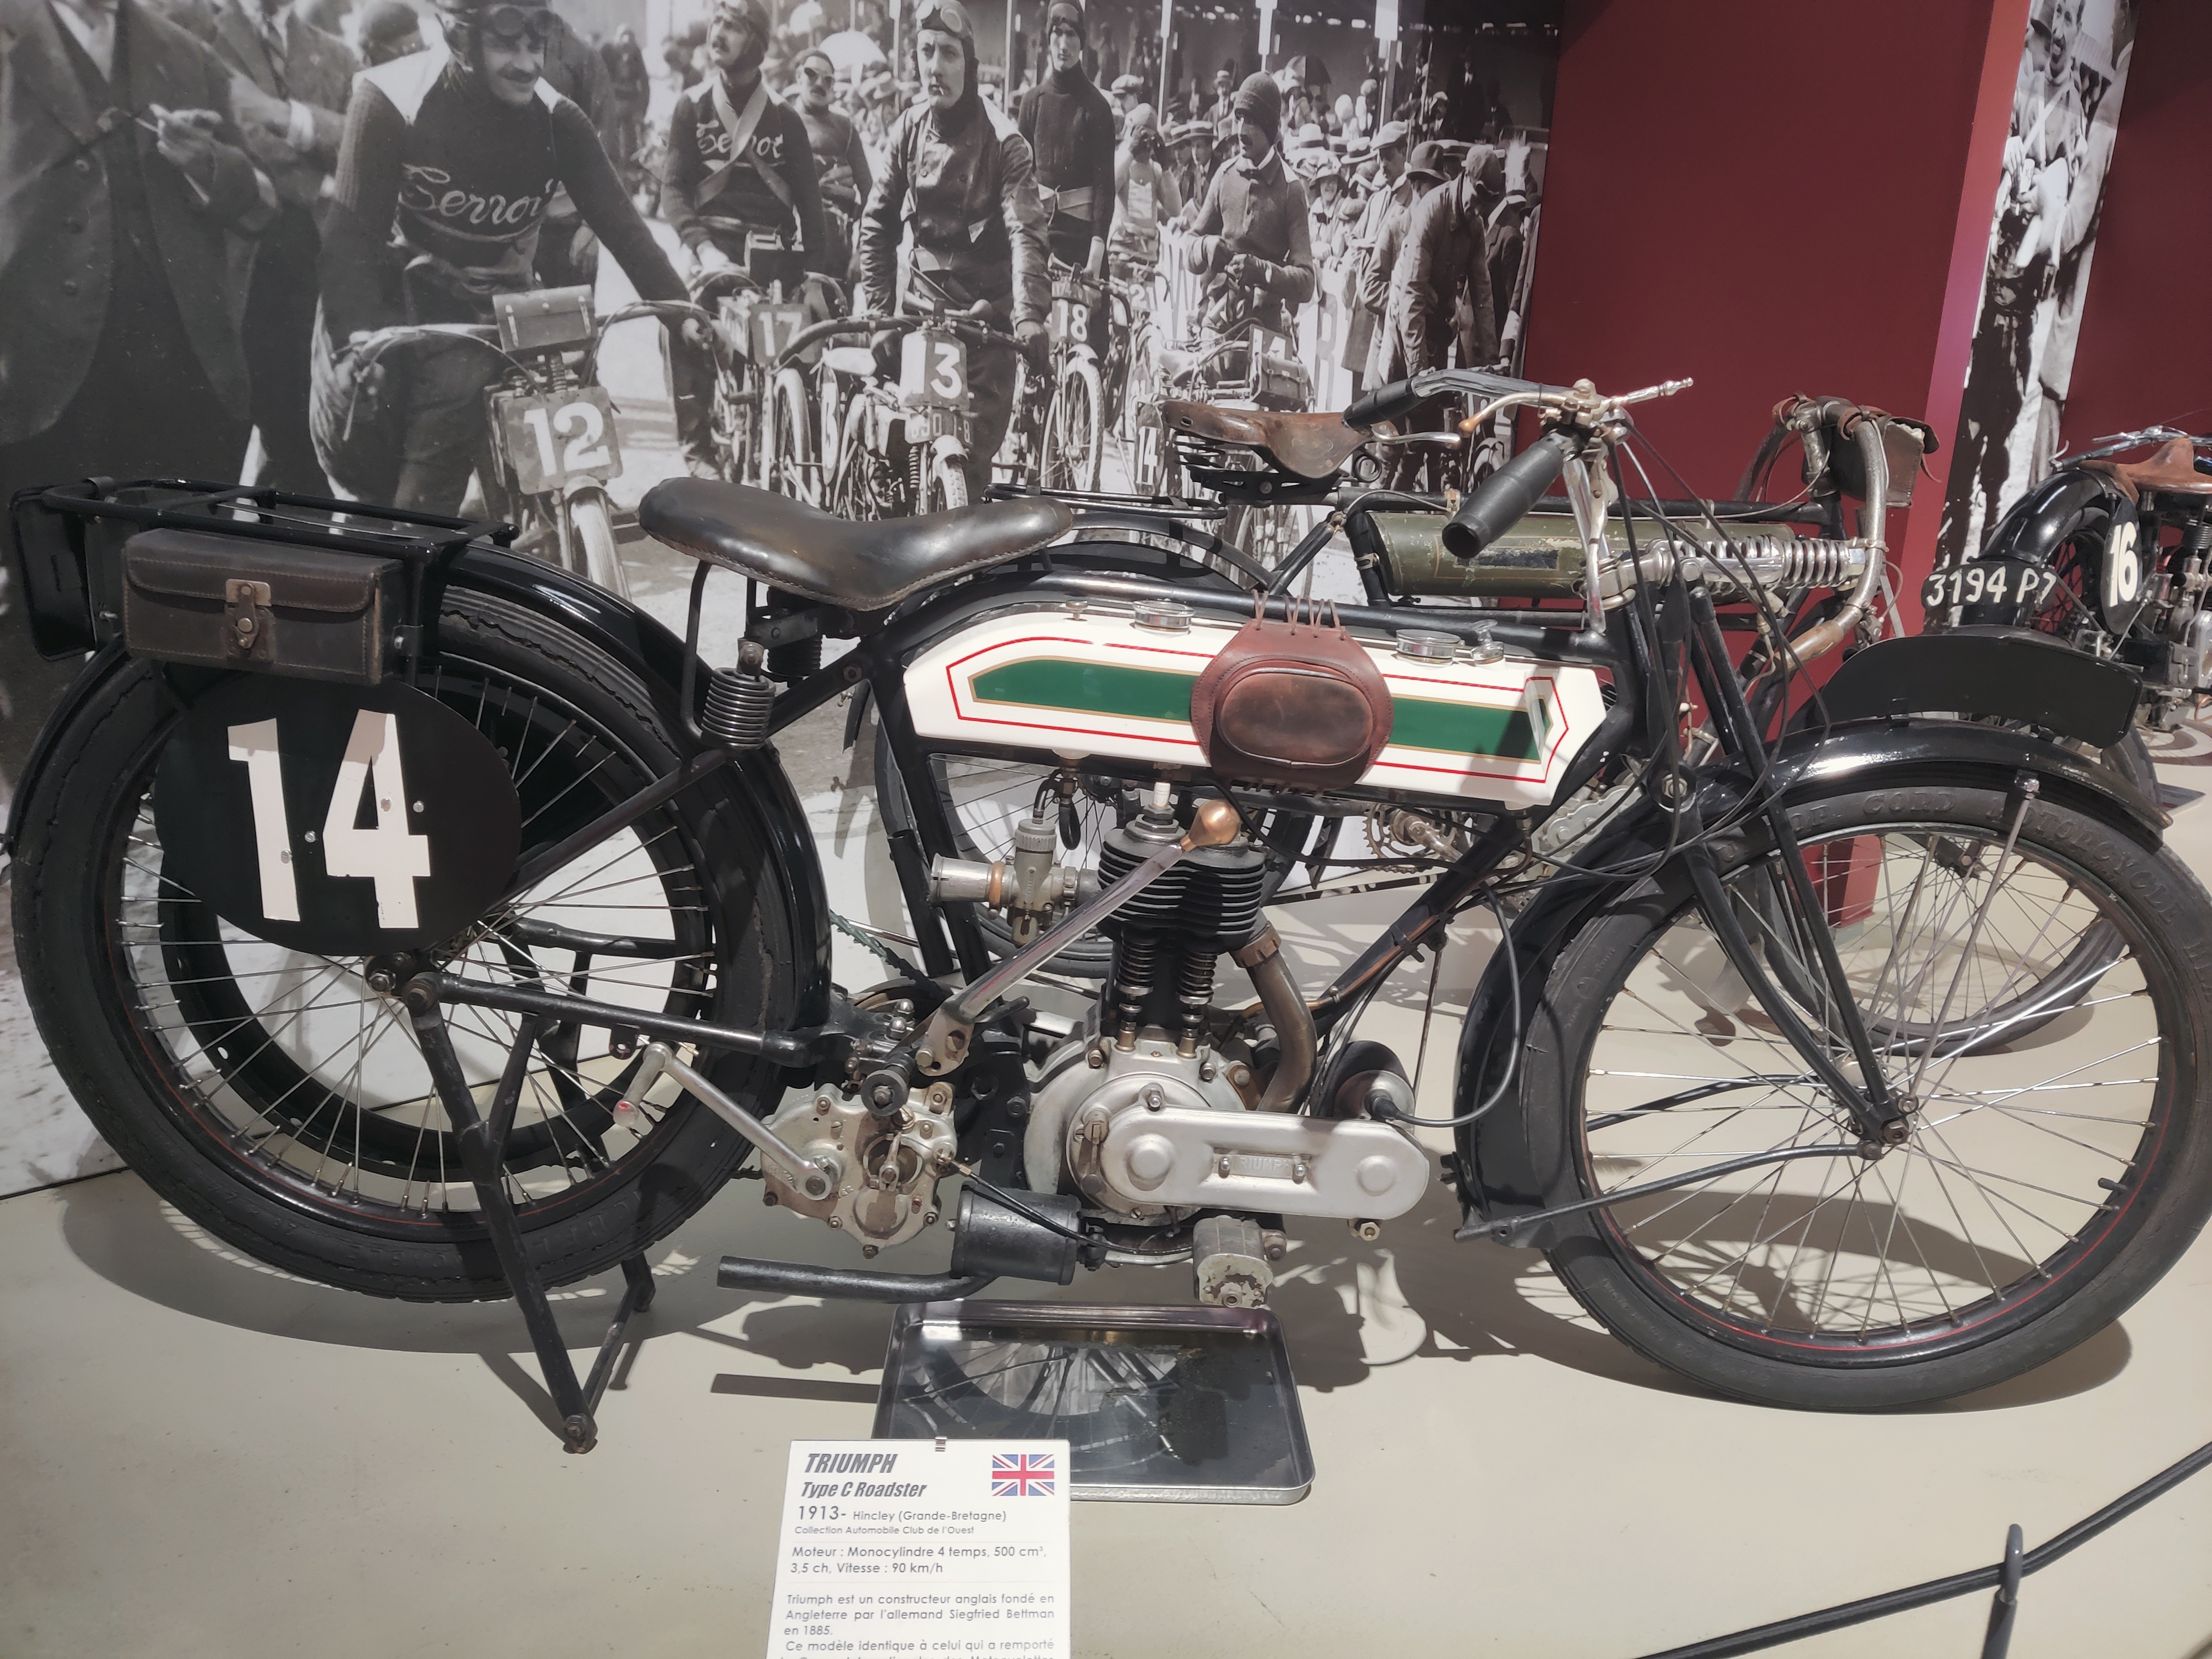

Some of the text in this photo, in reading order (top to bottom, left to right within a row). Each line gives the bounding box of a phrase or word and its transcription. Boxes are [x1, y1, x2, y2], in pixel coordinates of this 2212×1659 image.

[1057, 299, 1088, 342] 18
[758, 311, 802, 357] 17
[908, 333, 962, 399] 13
[524, 401, 612, 477] 12
[1136, 425, 1159, 486] 14
[2109, 521, 2138, 608] 16
[1926, 565, 2007, 607] 3194
[227, 708, 431, 928] 14
[804, 1453, 899, 1474] TRIUMPH
[801, 1481, 928, 1499] Type C Roadster
[799, 1505, 1006, 1522] 1913- Hincley (Grande-Bretagne)
[794, 1526, 974, 1535] Collection Automobile Club de l'Ouest
[792, 1547, 837, 1557] Moteur
[847, 1546, 934, 1559] Monocylindre
[937, 1547, 945, 1557] 4
[948, 1546, 990, 1559] temps,
[994, 1547, 1015, 1557] 500
[790, 1563, 809, 1574] 3,5
[812, 1563, 832, 1574] ch,
[837, 1563, 880, 1573] Vitesse
[892, 1563, 906, 1573] 90
[910, 1562, 943, 1574] km/h
[787, 1594, 833, 1606] Triumph
[838, 1595, 855, 1604] est
[878, 1595, 951, 1604] constructeur
[955, 1594, 997, 1606] anglais
[1001, 1593, 1035, 1603] fondé
[785, 1609, 1054, 1622] Angleterre par l'allemand Siegfried Bettman
[804, 1626, 833, 1635] 1885.
[786, 1641, 803, 1651] Ce
[808, 1640, 854, 1651] modèle
[859, 1640, 915, 1653] identique
[920, 1639, 927, 1650] à
[932, 1640, 961, 1650] celui
[965, 1640, 983, 1652] qui
[1000, 1639, 1054, 1652] remporté
